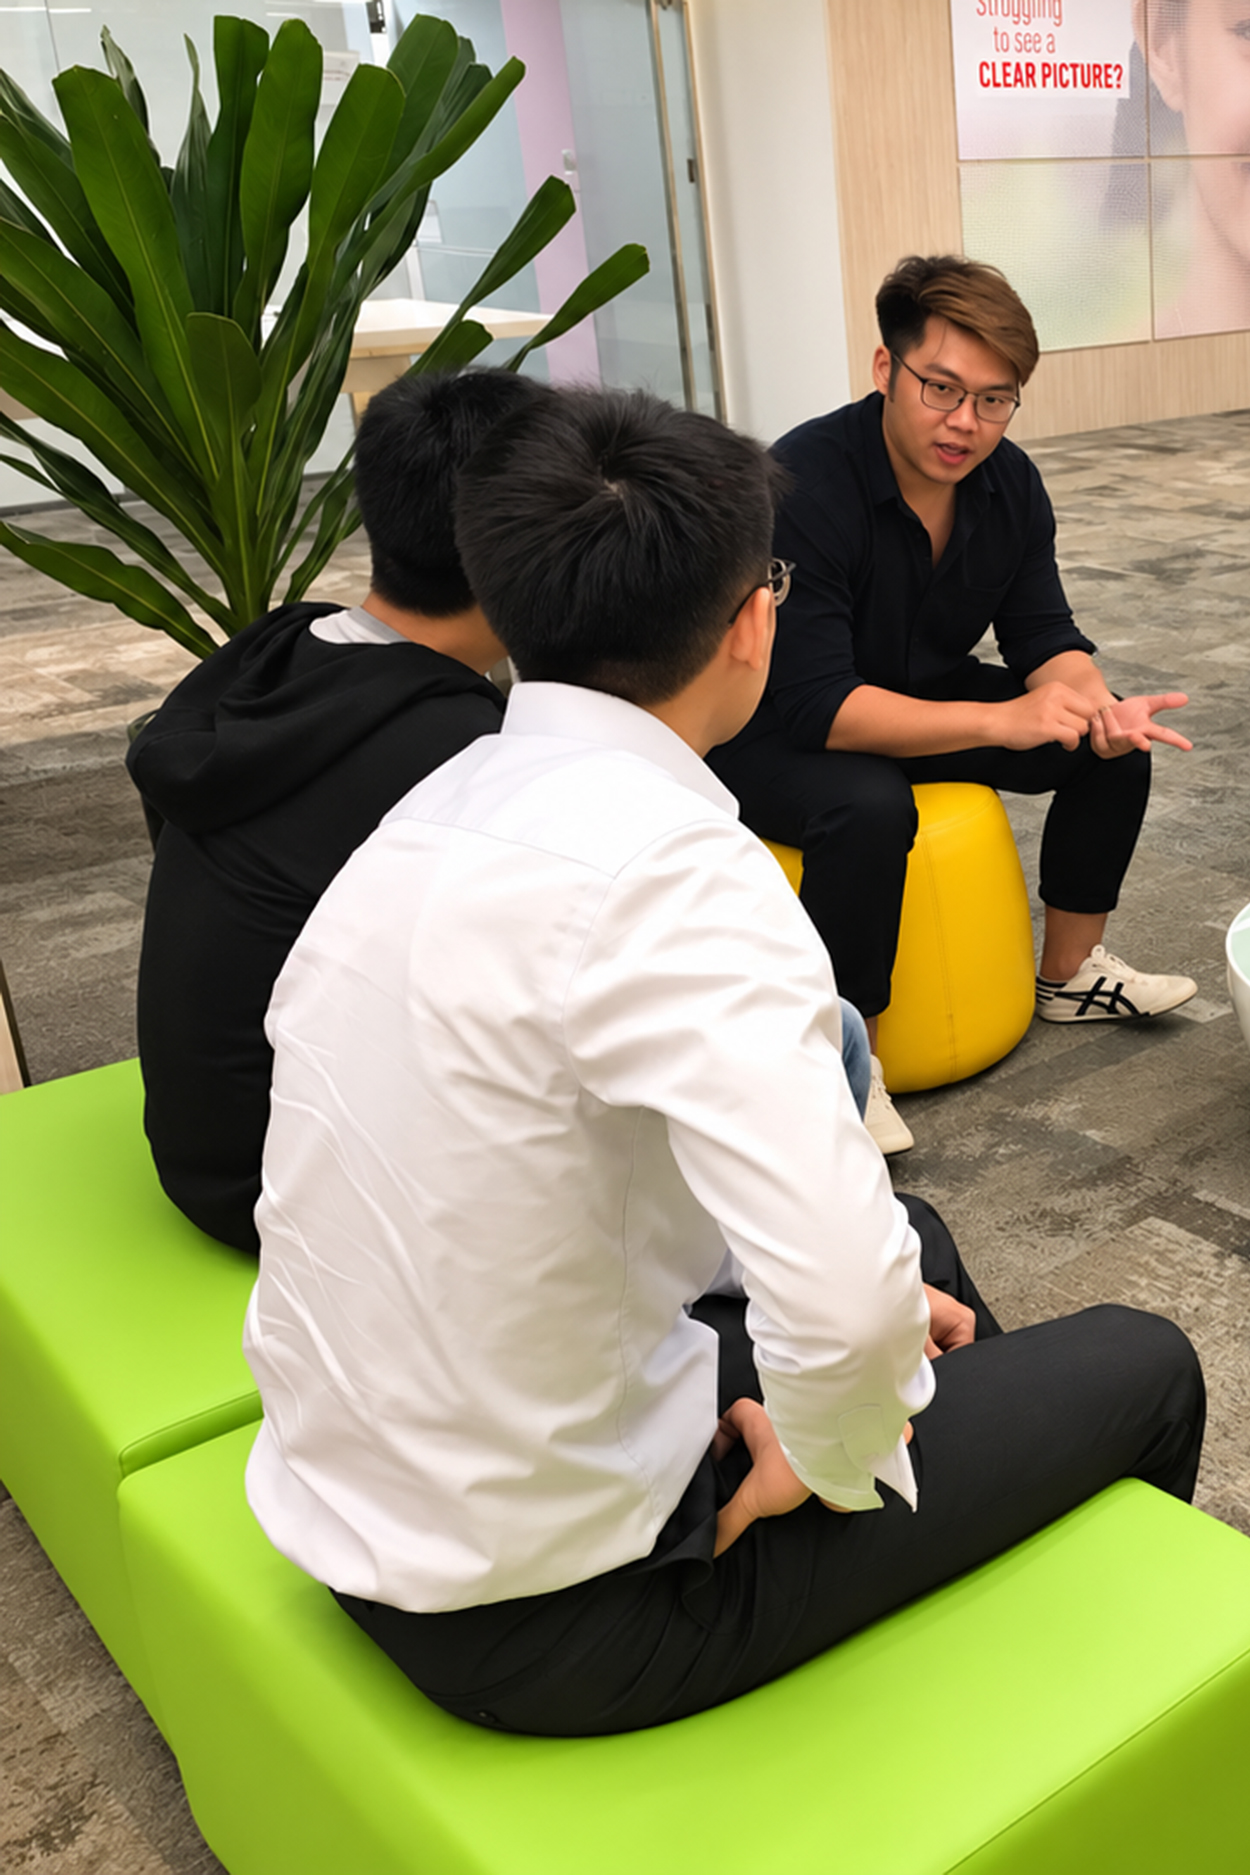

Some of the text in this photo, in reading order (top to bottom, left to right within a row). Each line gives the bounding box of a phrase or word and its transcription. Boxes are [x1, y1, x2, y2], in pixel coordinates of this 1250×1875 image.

[976, 0, 1063, 27] Struggling
[993, 26, 1056, 54] to see a
[978, 61, 1124, 90] CLEAR PICTURE?
